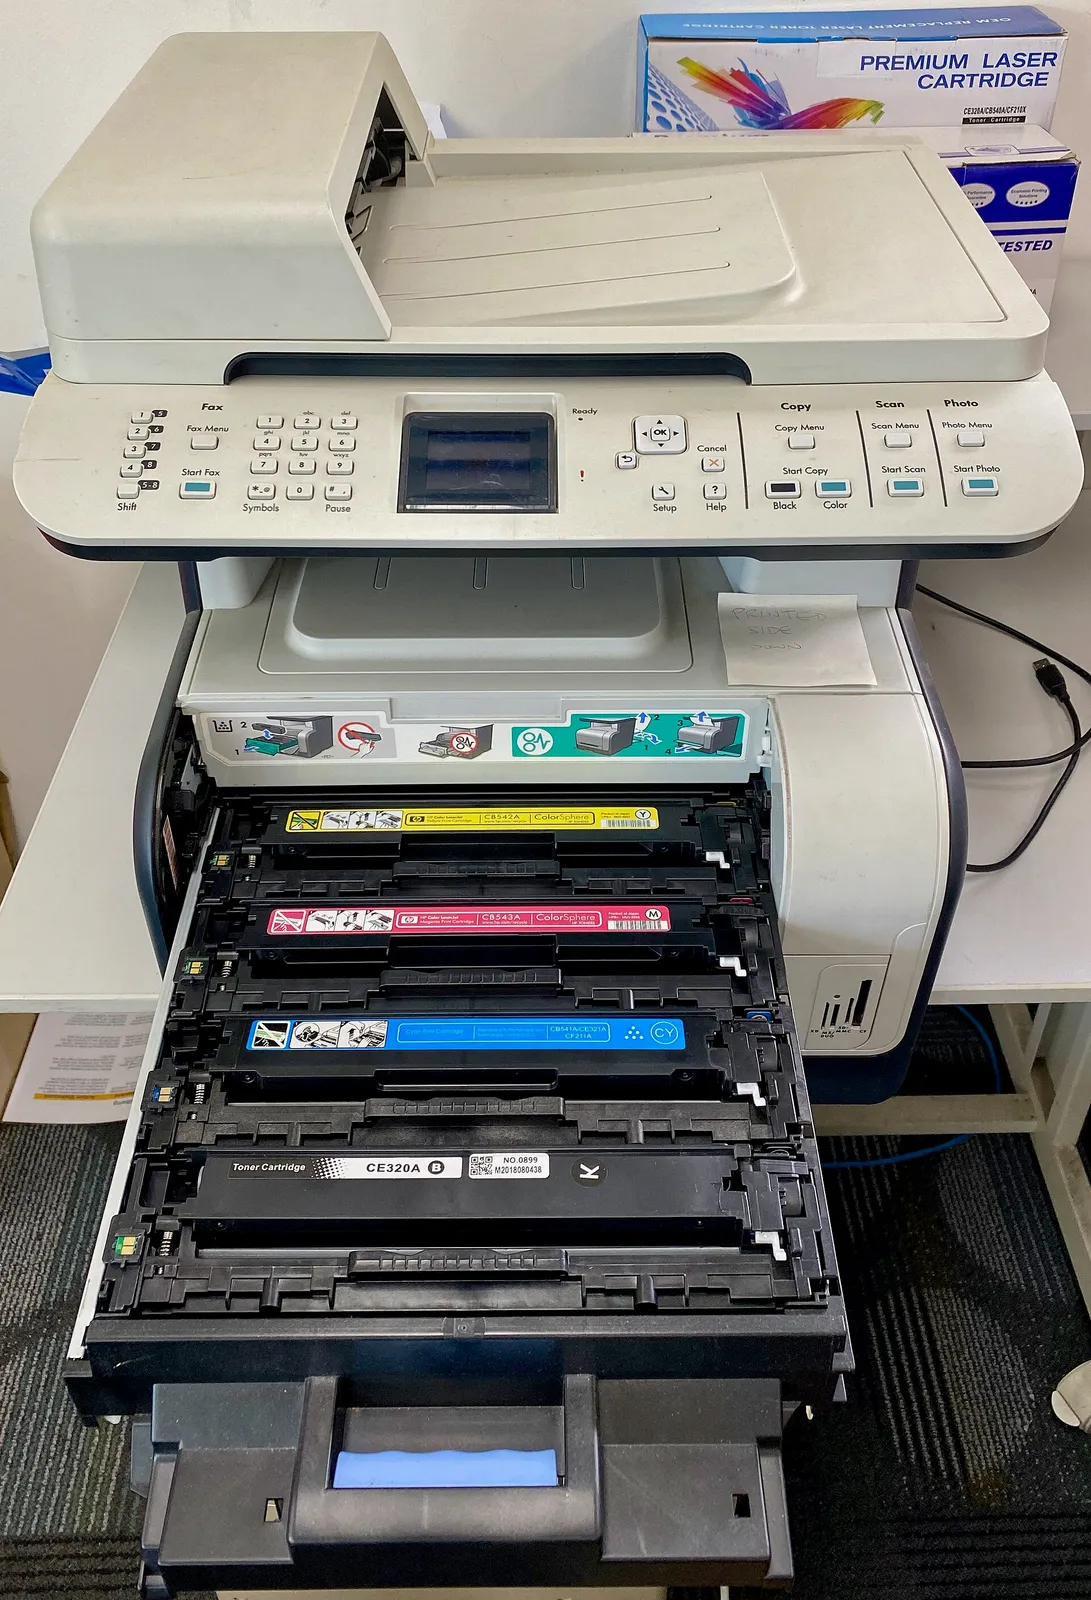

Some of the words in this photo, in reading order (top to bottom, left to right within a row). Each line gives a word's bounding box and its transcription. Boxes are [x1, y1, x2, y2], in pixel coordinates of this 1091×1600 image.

[868, 20, 971, 30] REPLACEMENT
[860, 53, 968, 71] PREMIUM
[982, 52, 1058, 69] LASER
[917, 71, 1050, 90] CARTRIDGE
[963, 106, 1027, 115] CE320A/CB540A/CF210X
[201, 403, 224, 412] Fax
[780, 403, 812, 412] Copy
[875, 400, 905, 408] Scan
[944, 399, 979, 407] Photo
[774, 424, 798, 432] Copy
[941, 421, 966, 429] Photo
[968, 421, 993, 429] Menu
[653, 428, 667, 436] OK
[181, 468, 202, 476] Start
[204, 468, 220, 476] Fax
[783, 467, 802, 475] Start
[804, 467, 828, 476] Copy
[881, 465, 902, 473] Start
[904, 465, 926, 473] Scan
[954, 465, 974, 473] Start
[976, 465, 1000, 473] Photo
[117, 502, 137, 511] Shift
[243, 503, 280, 513] Symbols
[325, 504, 351, 513] Pause
[653, 504, 677, 513] Setup
[706, 503, 727, 512] Help
[773, 501, 797, 510] Black
[823, 501, 848, 510] Color
[731, 607, 827, 621] PRINTED
[748, 625, 792, 635] SIDE
[534, 813, 589, 821] ColorSphere
[536, 913, 595, 922] ColorSphere
[654, 1028, 674, 1038] CY
[503, 1156, 538, 1164] NO.0899
[233, 1163, 260, 1171] Toner
[261, 1163, 306, 1173] Cartridge
[366, 1163, 421, 1173] CE320A
[495, 1166, 542, 1174] M2018080438
[580, 1163, 599, 1179] K
